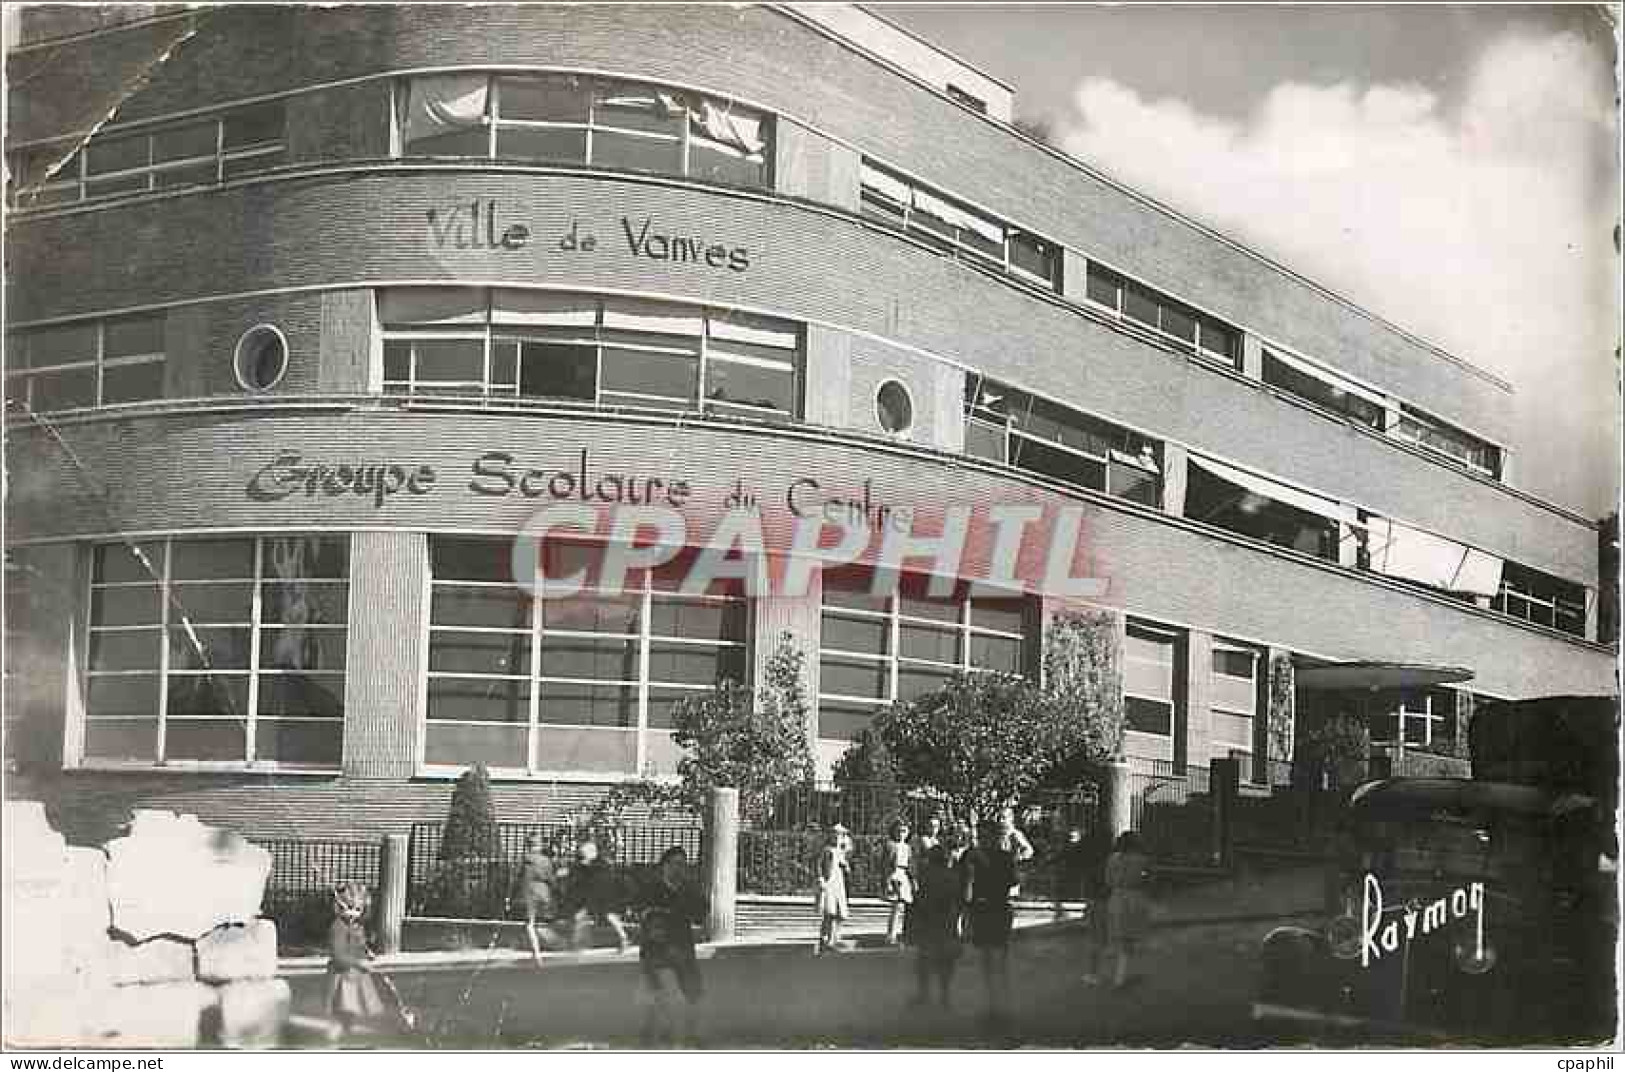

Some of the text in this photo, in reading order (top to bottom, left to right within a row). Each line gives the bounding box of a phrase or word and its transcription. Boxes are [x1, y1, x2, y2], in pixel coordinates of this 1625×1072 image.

[426, 199, 750, 272] Ville de Vanves
[246, 447, 913, 536] Groupe Scolaire du Centre
